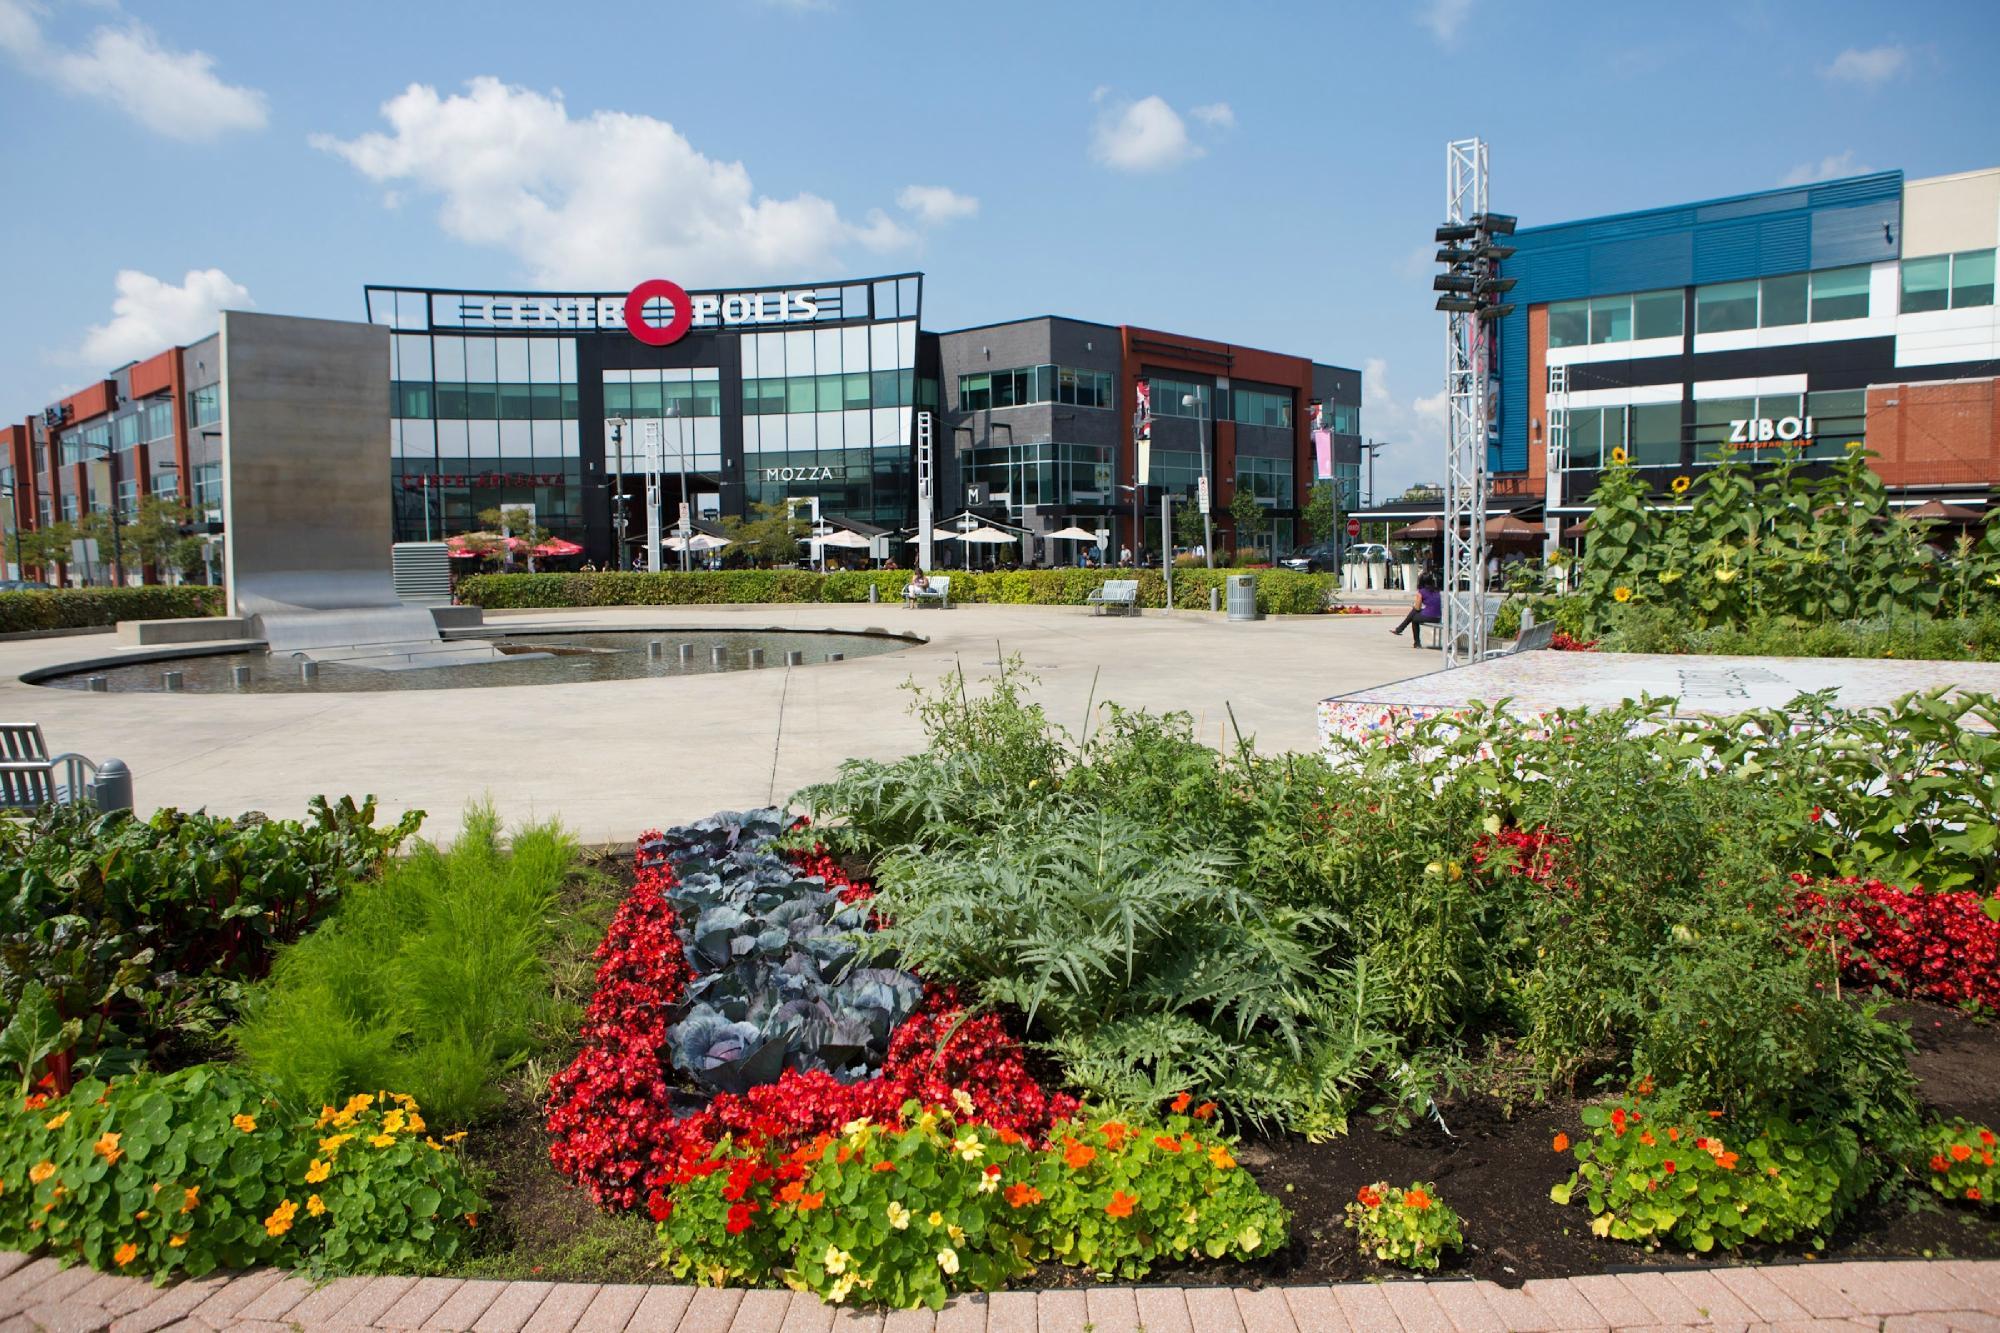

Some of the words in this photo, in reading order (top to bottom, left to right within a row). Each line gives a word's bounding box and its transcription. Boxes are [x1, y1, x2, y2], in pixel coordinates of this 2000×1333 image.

[482, 279, 820, 347] CENTROPOLIS
[1729, 416, 1812, 443] ZIBO!
[767, 466, 833, 482] MOZZA
